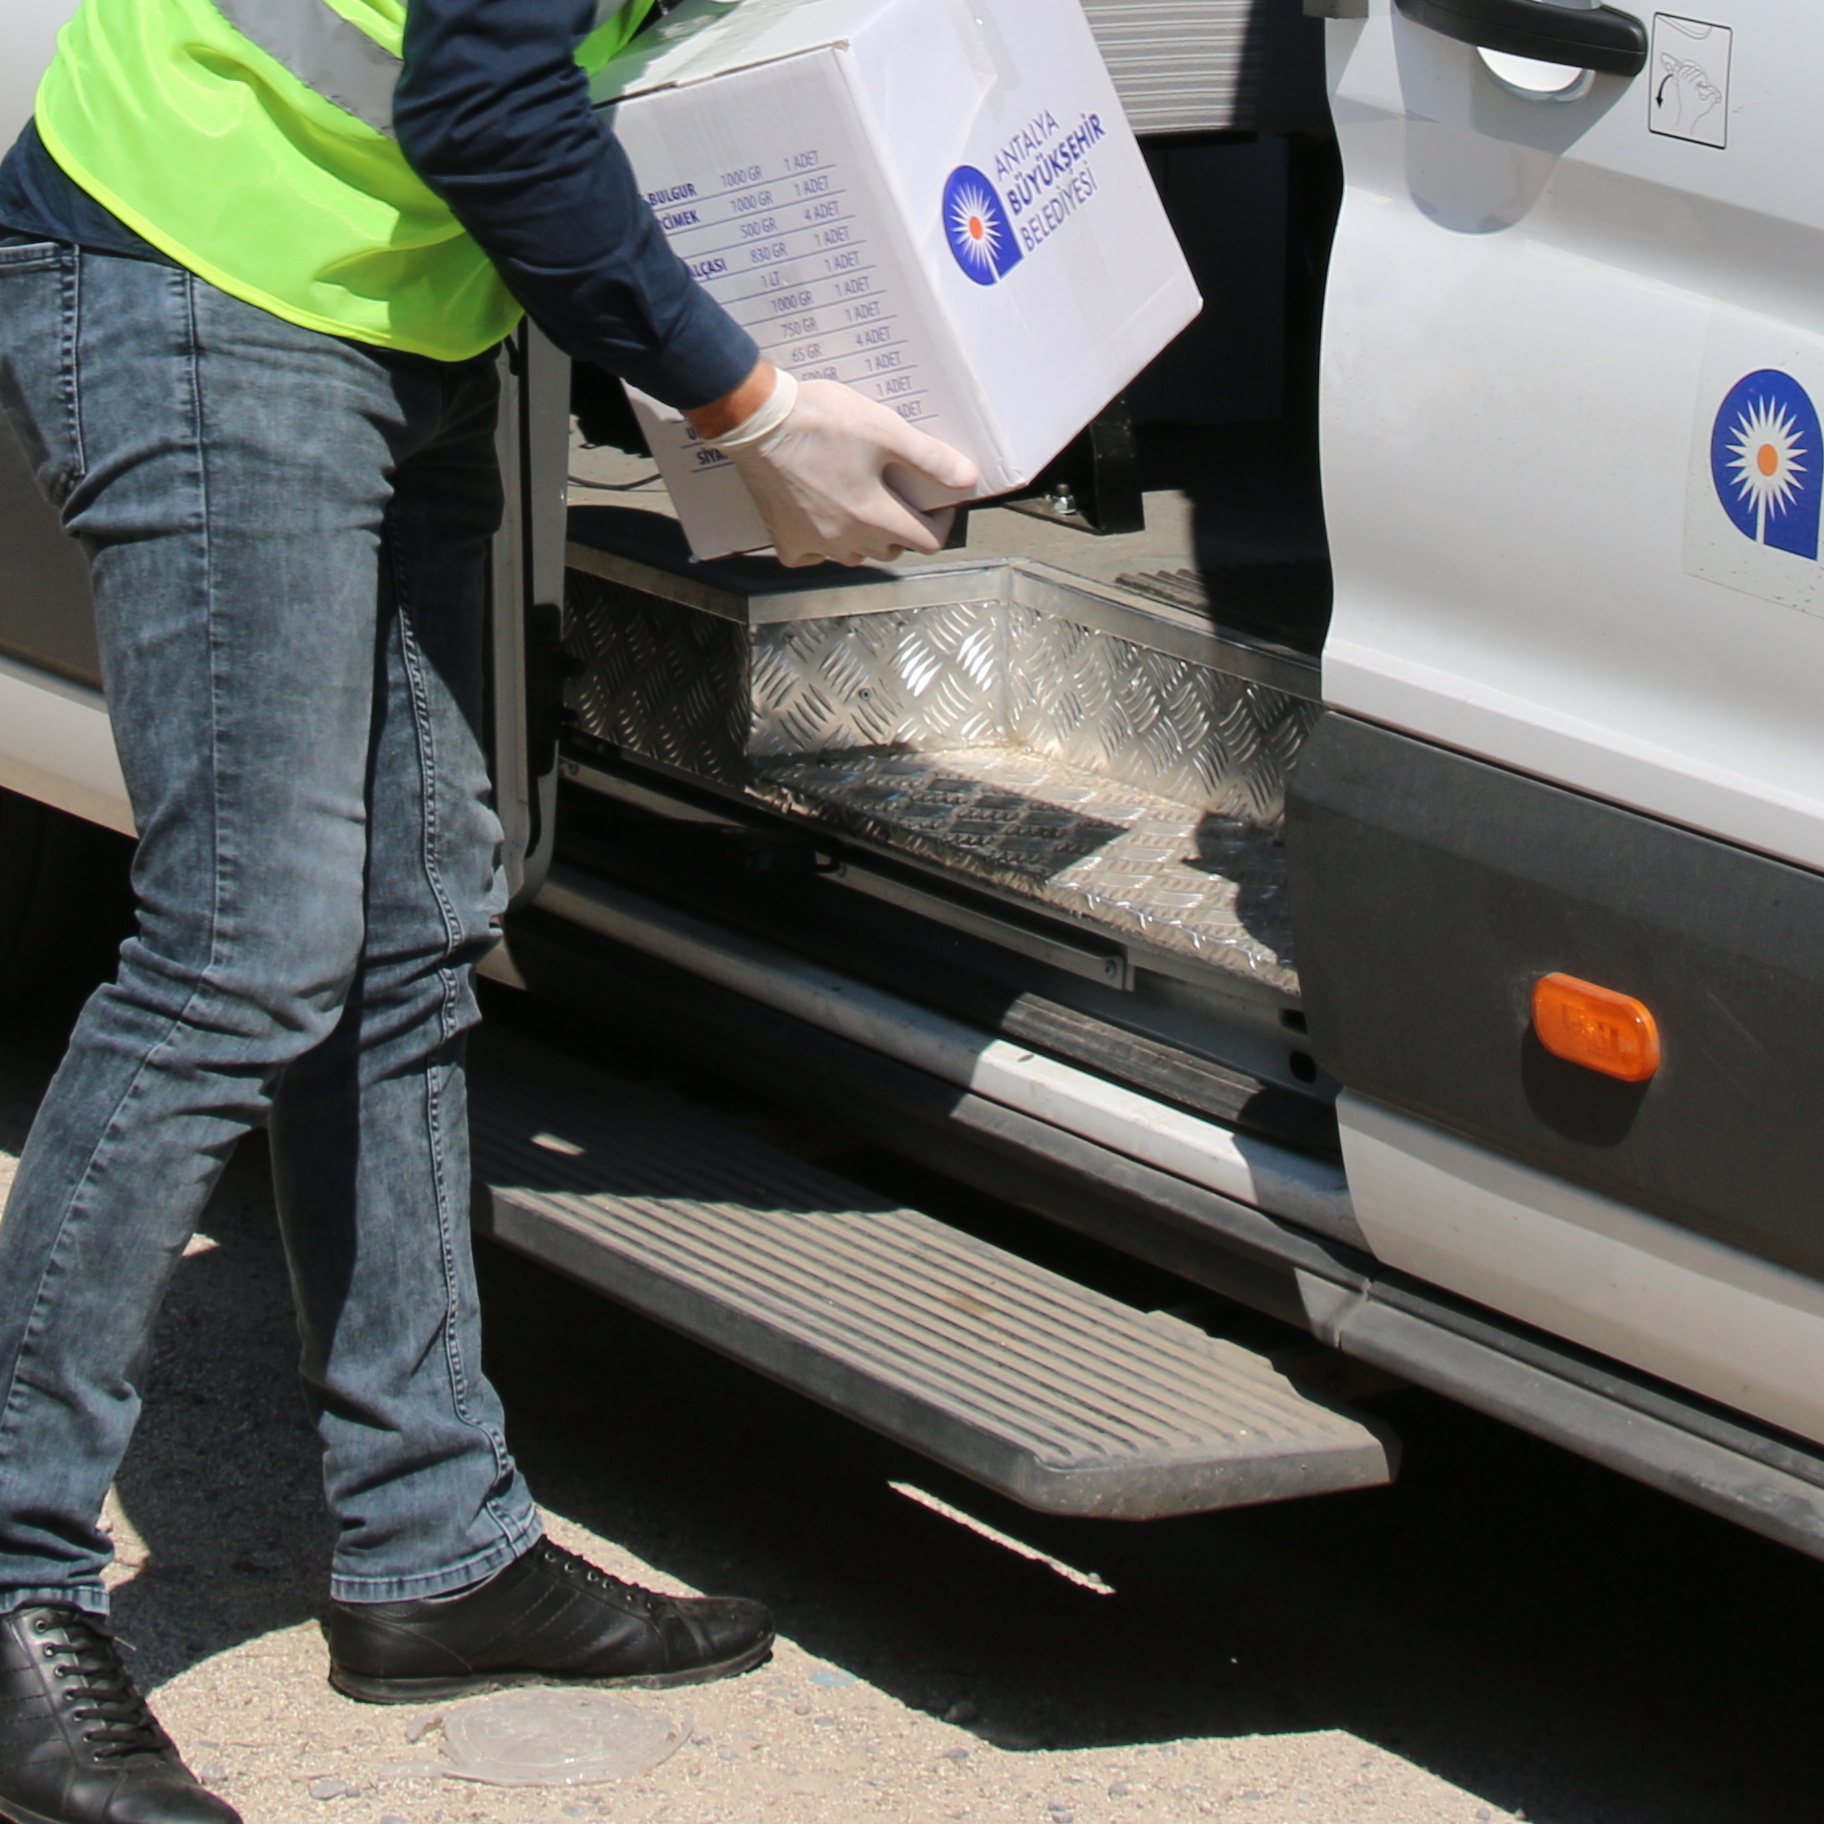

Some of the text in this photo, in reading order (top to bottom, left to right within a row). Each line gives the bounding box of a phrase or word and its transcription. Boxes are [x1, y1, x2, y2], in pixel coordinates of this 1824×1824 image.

[994, 108, 1060, 182] ANTALYA
[648, 183, 697, 206] BULGUR
[721, 169, 747, 187] 1000
[747, 165, 764, 182] GR
[793, 150, 820, 170] ADET
[1006, 112, 1106, 217] BÜYÜKŞEHİR
[662, 209, 701, 230] CİMEK
[730, 194, 756, 214] 1000
[758, 191, 774, 207] GR
[804, 175, 830, 195] ADET
[740, 220, 761, 238] 500
[761, 217, 777, 233] GR
[814, 201, 840, 219] ADET
[1020, 160, 1098, 253] BELEDİYESİ
[690, 258, 727, 281] LÇASI
[750, 246, 770, 264] 830
[771, 243, 787, 258] GR
[824, 226, 850, 245] ADET
[834, 251, 860, 270] ADET
[771, 295, 798, 313] 1000
[799, 291, 816, 307] GR
[844, 276, 870, 295] ADET
[781, 322, 802, 338] 750
[802, 317, 818, 333] GR
[854, 301, 881, 321] ADET
[792, 346, 806, 361] 65
[806, 343, 823, 359] GR
[865, 326, 891, 345] ADET
[875, 351, 901, 370] ADET
[885, 376, 912, 395] ADET
[896, 400, 922, 419] ADET
[697, 448, 728, 465] SİYA
